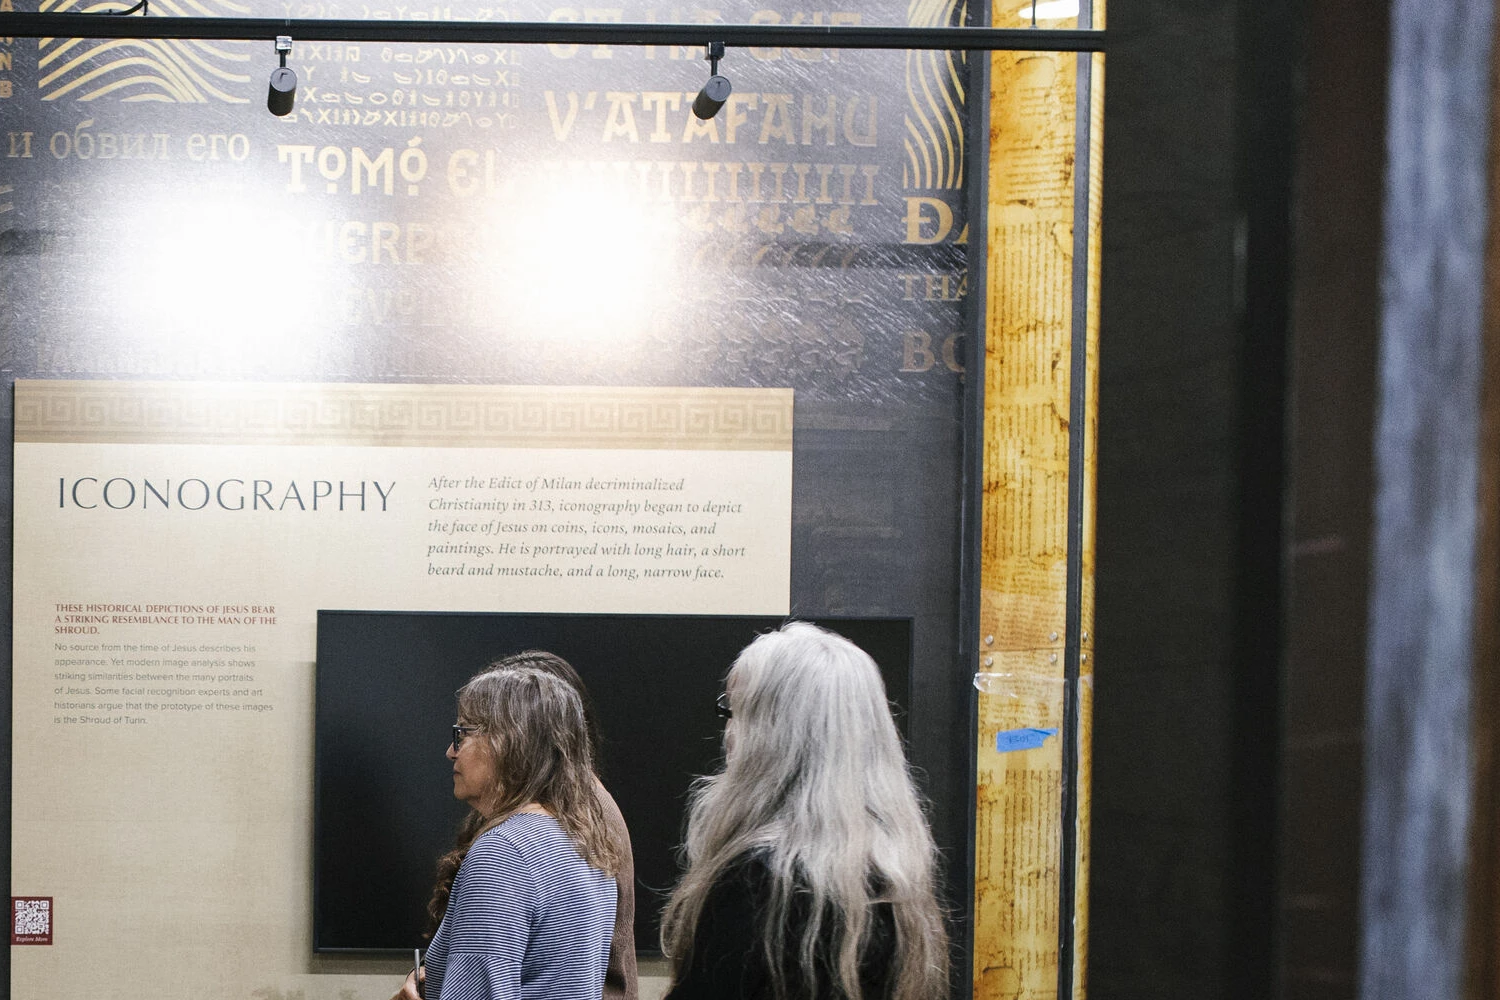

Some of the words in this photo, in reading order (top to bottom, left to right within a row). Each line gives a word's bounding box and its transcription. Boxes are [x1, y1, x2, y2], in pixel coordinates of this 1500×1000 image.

[7, 131, 33, 158] и
[49, 118, 172, 159] обвил
[186, 133, 249, 161] его
[427, 475, 462, 493] After
[464, 475, 486, 489] the
[488, 476, 523, 489] Edict
[525, 476, 540, 492] of
[541, 477, 582, 490] Milan
[585, 476, 685, 491] decriminalized
[59, 477, 396, 512] ICONOGRAPHY
[428, 497, 510, 515] Christianity
[512, 498, 526, 511] in
[528, 499, 555, 513] 313,
[559, 499, 641, 516] iconography
[643, 500, 683, 516] began
[686, 503, 700, 513] to
[702, 501, 742, 517] depict
[427, 520, 449, 533] the
[449, 520, 477, 535] face
[481, 520, 495, 535] of
[495, 521, 529, 536] Jesus
[531, 524, 548, 533] on
[550, 521, 589, 535] coins,
[592, 522, 628, 536] icons,
[632, 521, 687, 536] mosaics,
[690, 521, 717, 535] and
[426, 541, 494, 558] paintings.
[498, 543, 517, 555] He
[519, 541, 531, 555] is
[532, 542, 599, 559] portrayed
[600, 542, 631, 556] with
[634, 542, 663, 560] long
[666, 543, 697, 559] hair,
[700, 547, 709, 557] a
[712, 543, 745, 557] short
[427, 562, 466, 576] beard
[467, 563, 494, 576] and
[497, 563, 563, 577] mustache,
[566, 564, 594, 577] and
[595, 568, 604, 577] a
[607, 564, 639, 581] long,
[643, 567, 692, 578] narrow
[694, 565, 725, 582] face.
[54, 603, 84, 613] THESE
[86, 603, 142, 614] HISTORICAL
[145, 604, 204, 614] DEPICTIONS
[206, 604, 220, 614] OF
[222, 605, 249, 615] JESUS
[251, 605, 276, 614] BEAR
[54, 615, 62, 623] A
[64, 614, 109, 624] STRIKING
[111, 615, 179, 625] RESEMBLANCE
[181, 615, 195, 625] TO
[197, 616, 215, 625] THE
[217, 616, 241, 625] MAN
[243, 616, 257, 625] OF
[260, 616, 277, 625] THE
[54, 625, 101, 635] SHROUD.
